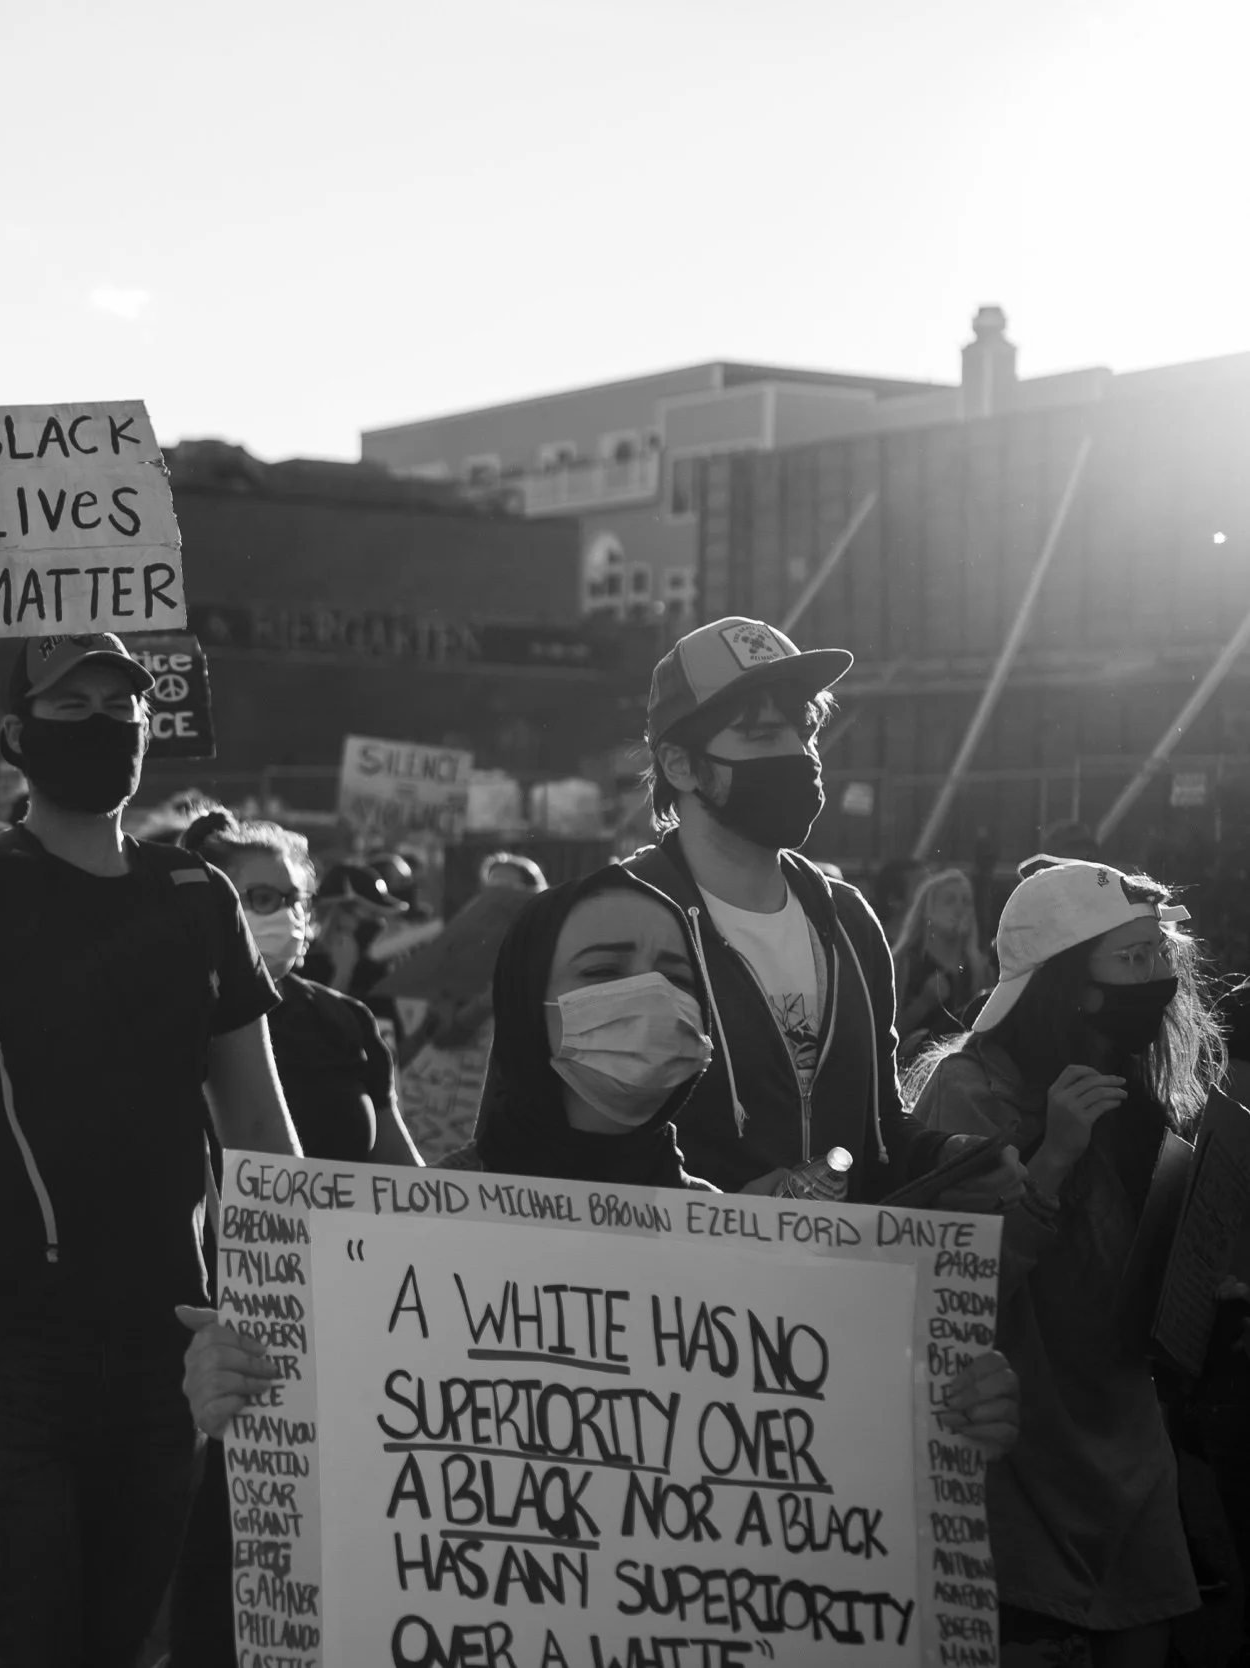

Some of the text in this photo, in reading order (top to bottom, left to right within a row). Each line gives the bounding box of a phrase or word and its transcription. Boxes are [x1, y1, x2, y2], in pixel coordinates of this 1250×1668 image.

[149, 711, 199, 740] CE
[236, 1158, 977, 1249] GEORGE FLOYD MICHAEL BROWN EZELL FORD DANTE
[222, 1204, 311, 1246] BREONNA
[220, 1248, 307, 1287] TAYLOR
[934, 1249, 999, 1281] PARKER
[388, 1263, 430, 1340] A
[452, 1272, 630, 1364] WHITE
[650, 1294, 740, 1379] HAS
[746, 1307, 831, 1395] NO
[266, 1354, 302, 1381] IR
[928, 1342, 974, 1376] BEN
[230, 1414, 317, 1447] TRAYVON
[376, 1368, 828, 1486] SUPERIORITY OVER
[227, 1447, 310, 1478] MARTIN
[231, 1476, 298, 1513] OSCAR
[386, 1452, 889, 1560] A BLACK NOR A BLACK
[233, 1506, 304, 1539] GRANT
[235, 1572, 321, 1618] GARNER
[393, 1531, 916, 1647] HAS ANY SUPERIORITY
[237, 1610, 322, 1651] PHILANDO
[390, 1613, 515, 1668] OVER
[543, 1629, 570, 1668] A
